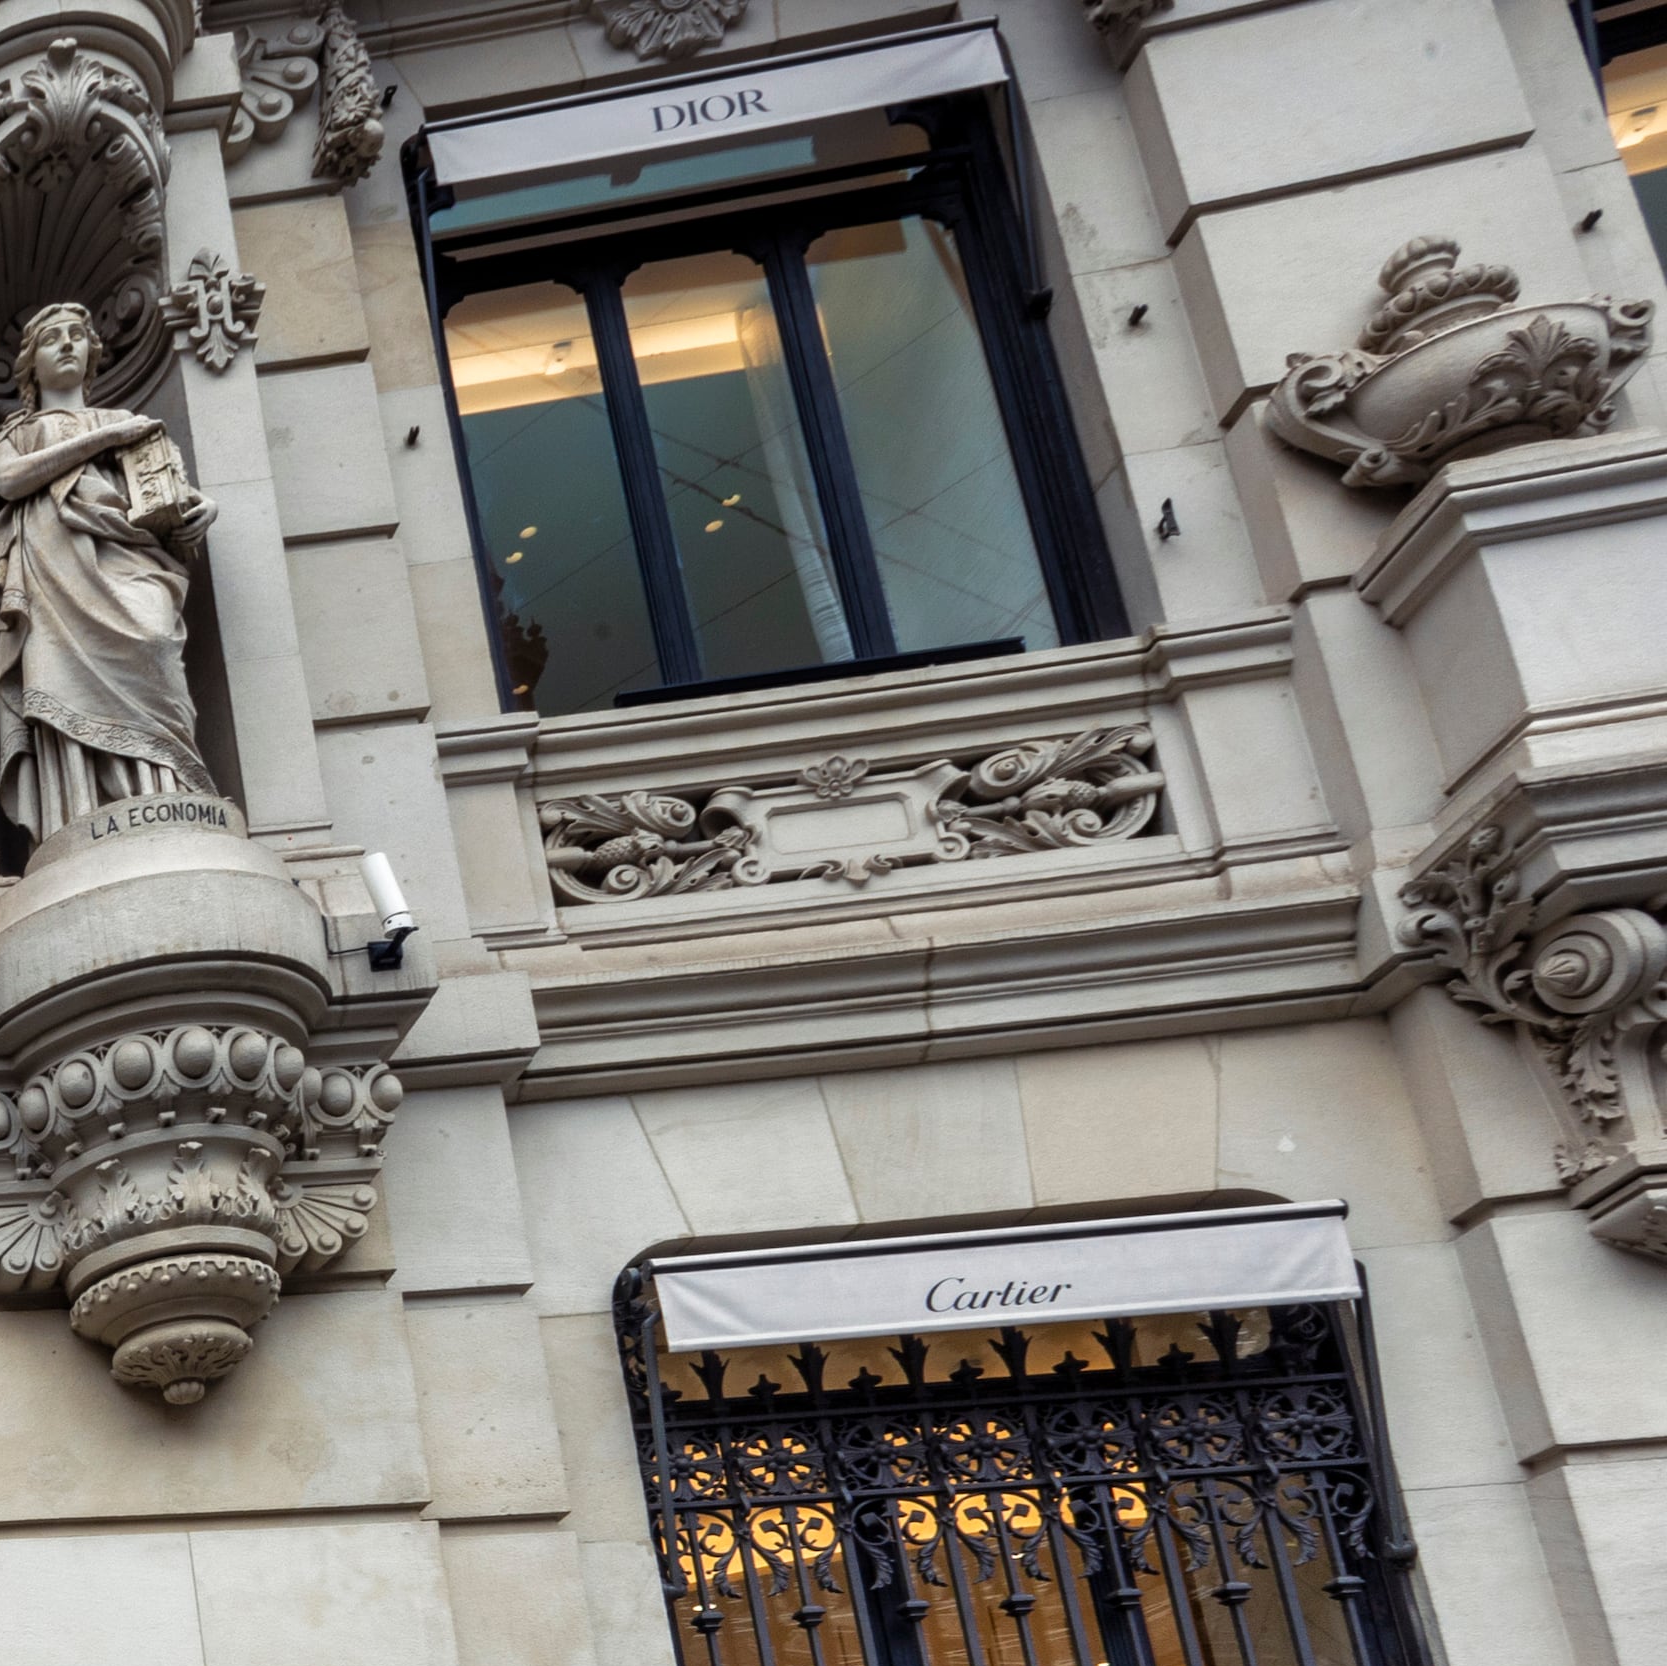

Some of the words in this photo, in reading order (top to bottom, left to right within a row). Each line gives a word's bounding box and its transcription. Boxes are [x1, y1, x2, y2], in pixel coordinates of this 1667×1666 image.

[650, 88, 771, 133] DIOR
[90, 815, 120, 841] LA
[127, 803, 228, 829] ECONOMIA
[925, 1277, 1072, 1313] Cartier
